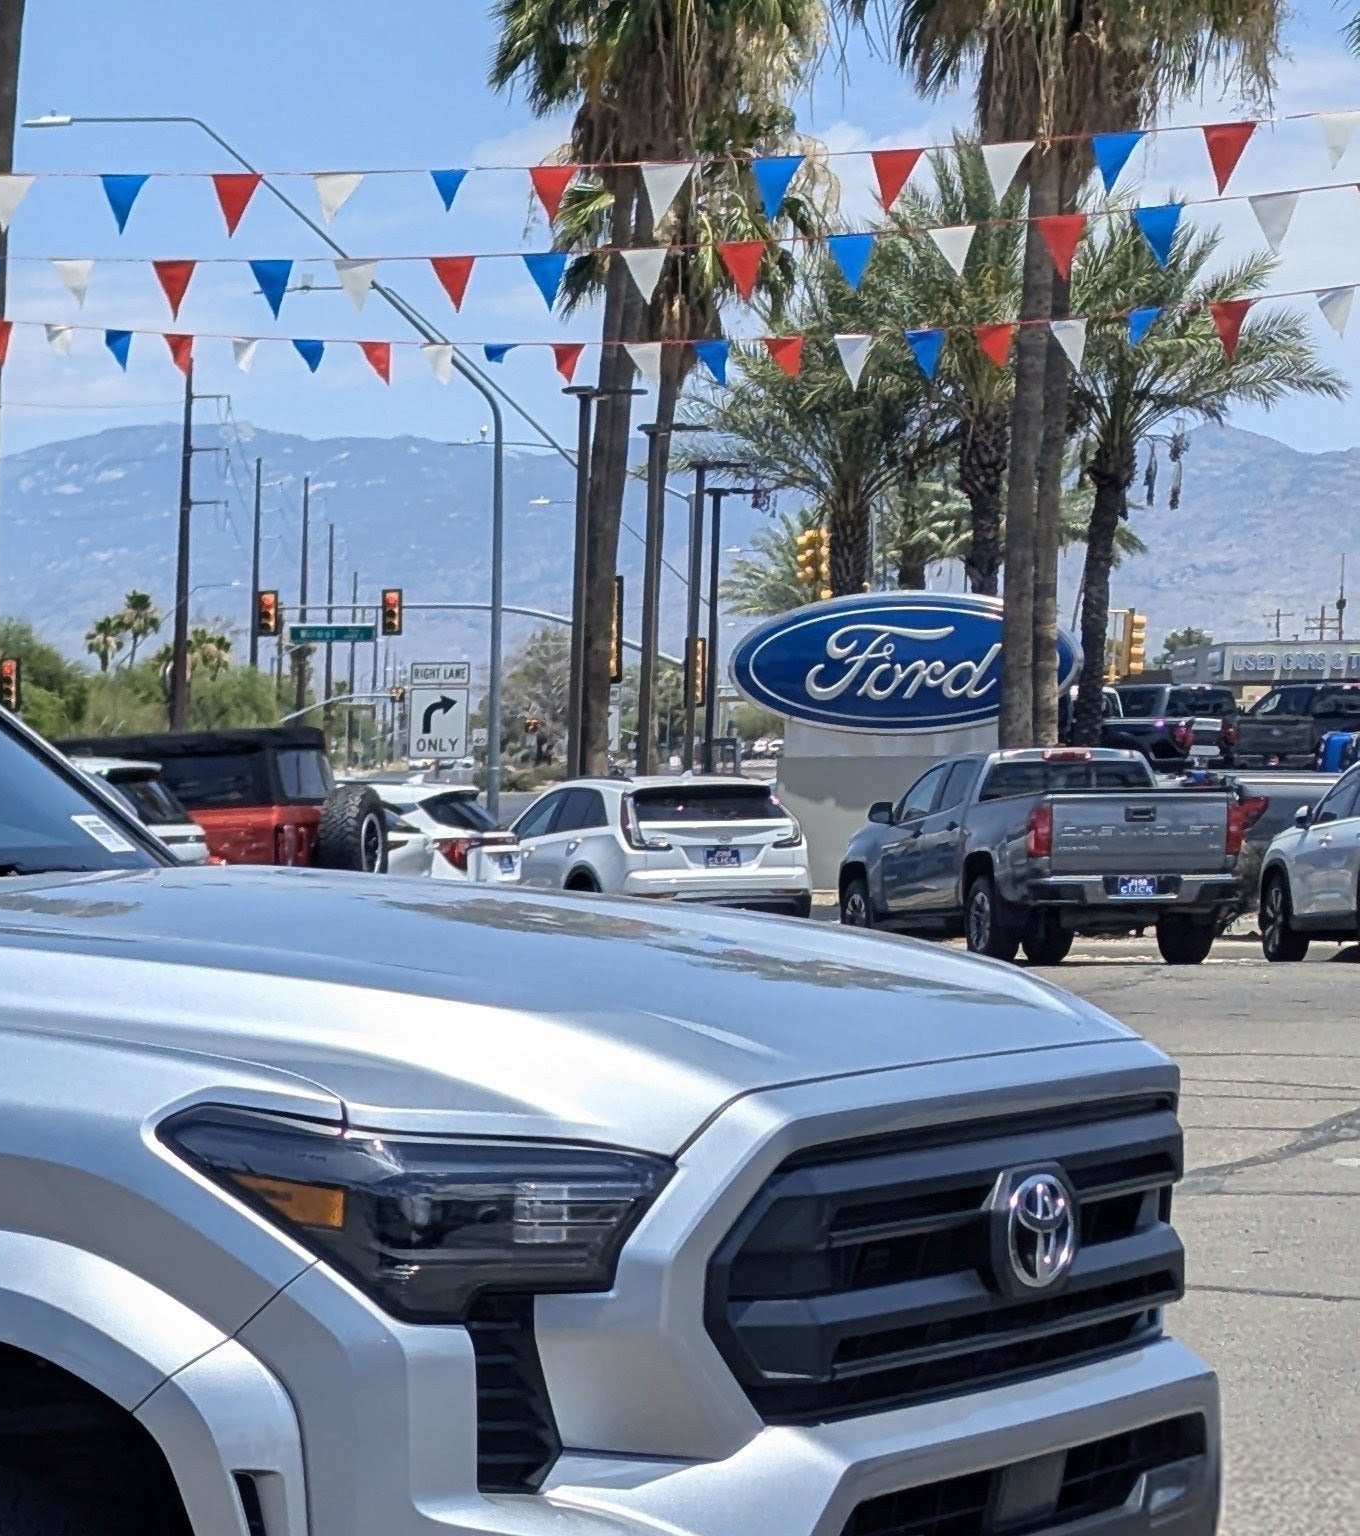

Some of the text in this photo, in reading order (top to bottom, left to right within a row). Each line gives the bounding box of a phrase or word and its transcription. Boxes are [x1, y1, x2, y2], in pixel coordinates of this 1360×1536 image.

[804, 623, 1003, 701] Ford
[1233, 652, 1277, 671] USED
[1282, 651, 1326, 671] CARS
[413, 667, 467, 680] RIGHT LANE
[416, 737, 459, 752] ONLY
[1120, 885, 1154, 894] CLICK
